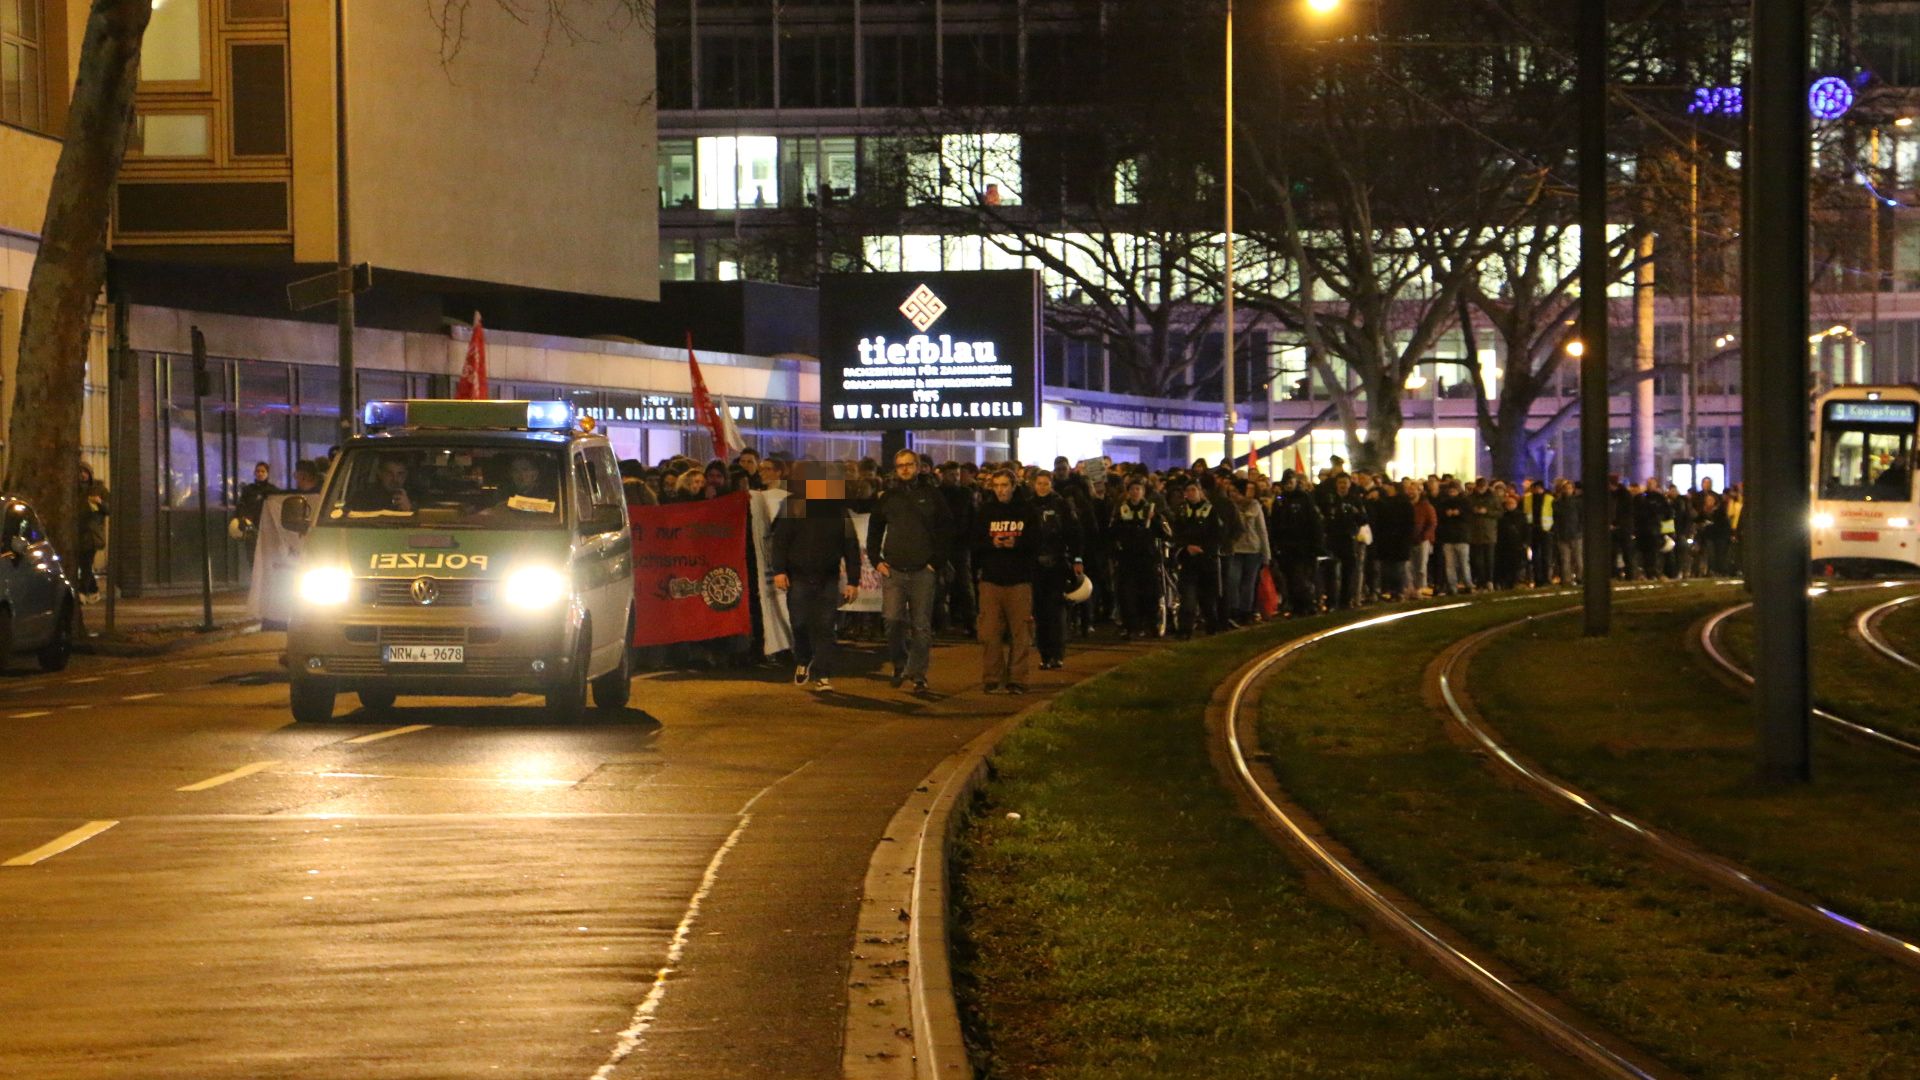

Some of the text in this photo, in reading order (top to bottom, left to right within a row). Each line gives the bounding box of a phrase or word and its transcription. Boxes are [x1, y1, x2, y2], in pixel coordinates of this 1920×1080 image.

[858, 334, 997, 365] tiefblau
[833, 402, 1023, 419] WWW.TIEFBLAU.KOELN
[389, 647, 412, 660] NRW
